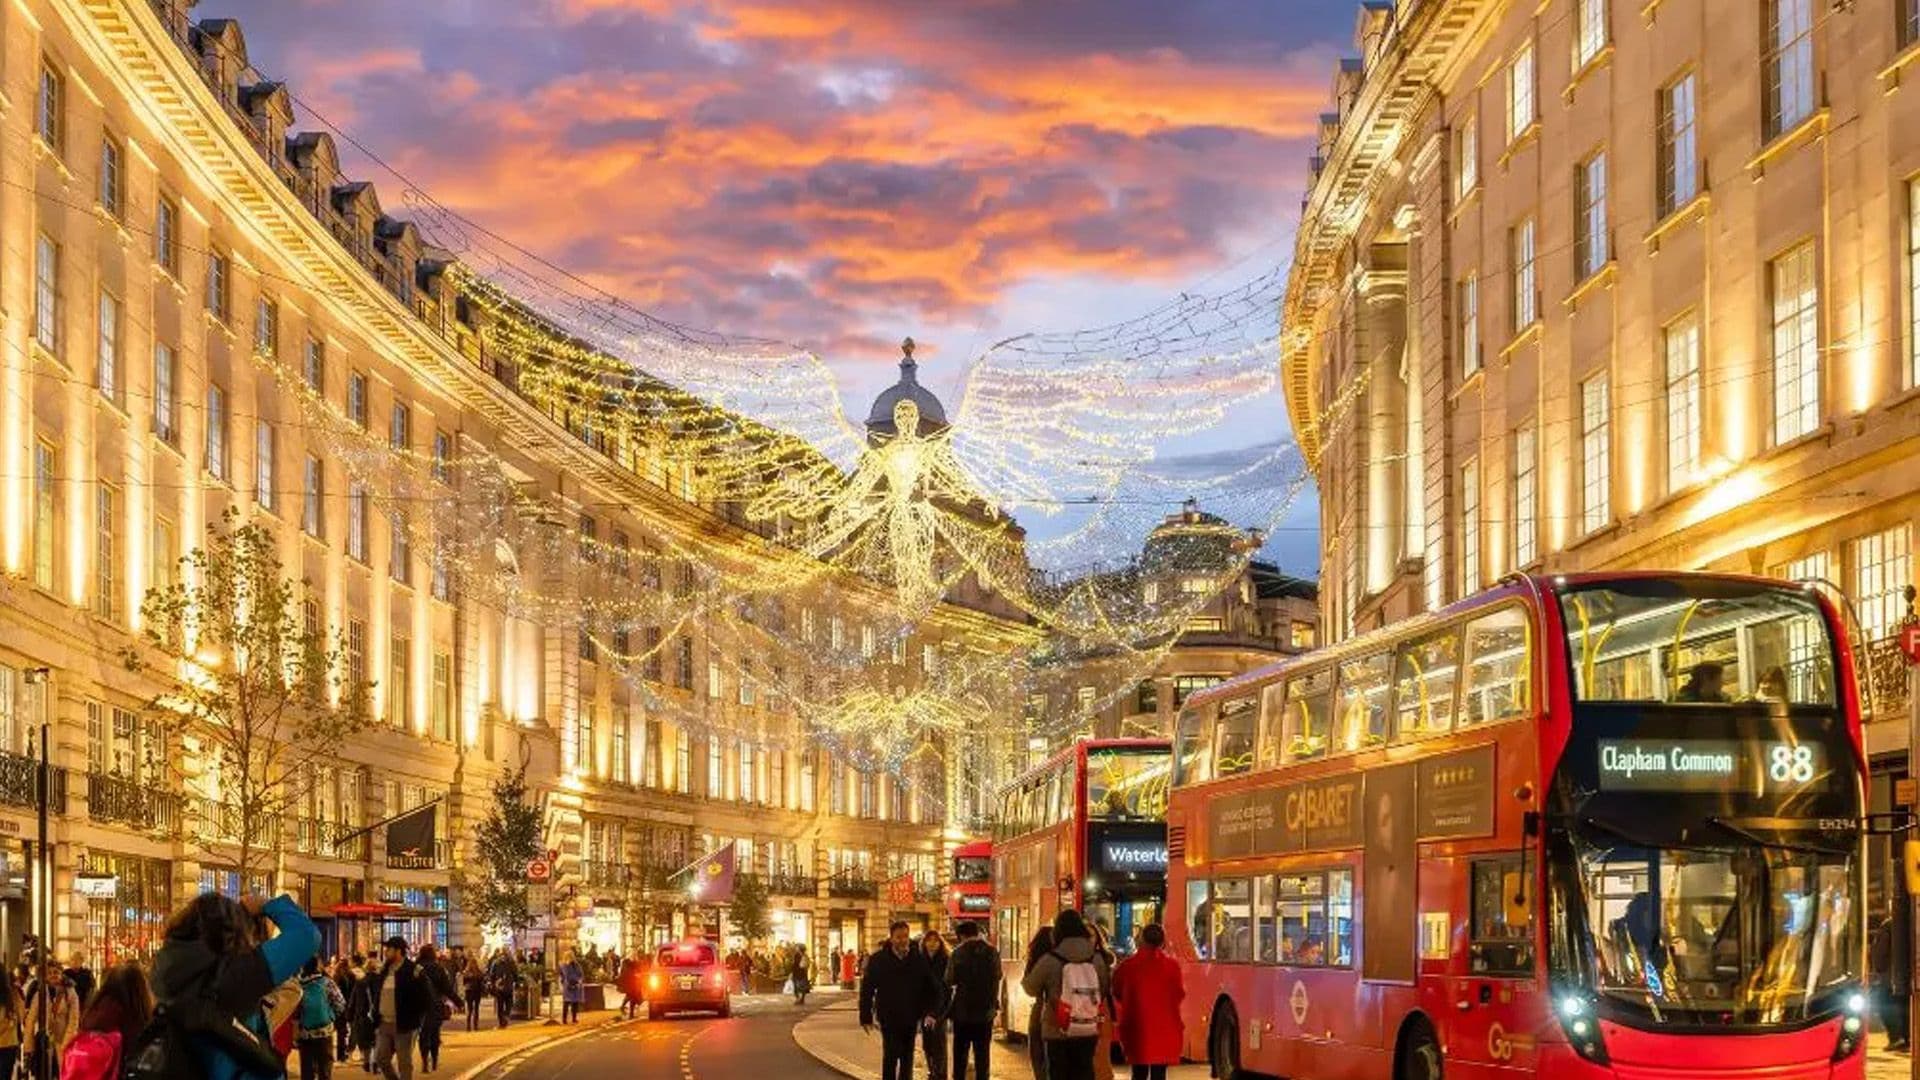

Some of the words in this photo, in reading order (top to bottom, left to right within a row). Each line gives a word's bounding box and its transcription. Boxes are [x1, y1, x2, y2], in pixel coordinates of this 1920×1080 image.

[1602, 746, 1666, 778] Clapham
[1671, 747, 1732, 772] Common
[1770, 746, 1813, 782] 88
[1286, 784, 1354, 831] CABARET
